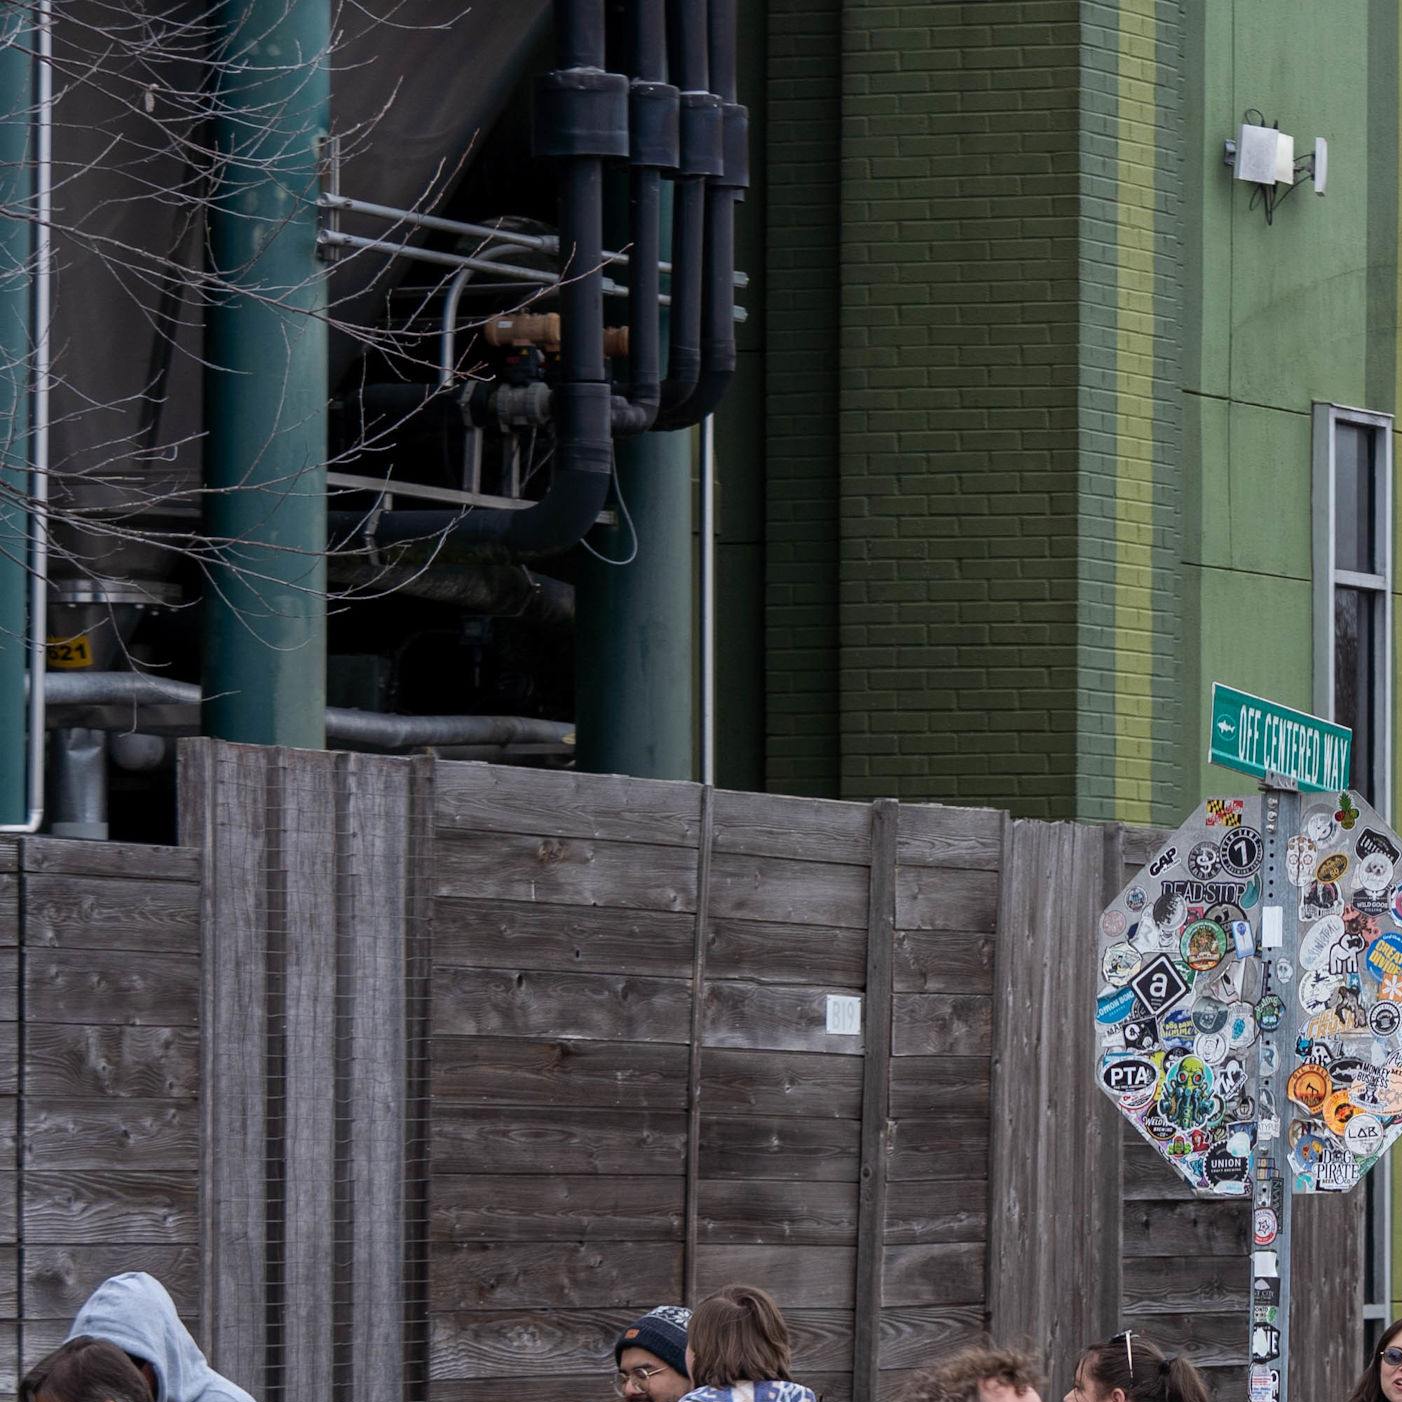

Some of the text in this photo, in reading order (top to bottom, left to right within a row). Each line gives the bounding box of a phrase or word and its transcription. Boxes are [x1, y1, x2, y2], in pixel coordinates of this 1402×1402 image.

[1238, 703, 1348, 792] OFF CENTERED WAY
[1149, 847, 1176, 877] GAP
[1233, 840, 1249, 866] 7
[1110, 1066, 1147, 1086] PTA
[1211, 1158, 1242, 1169] UNION
[1317, 1164, 1359, 1180] PIRATE
